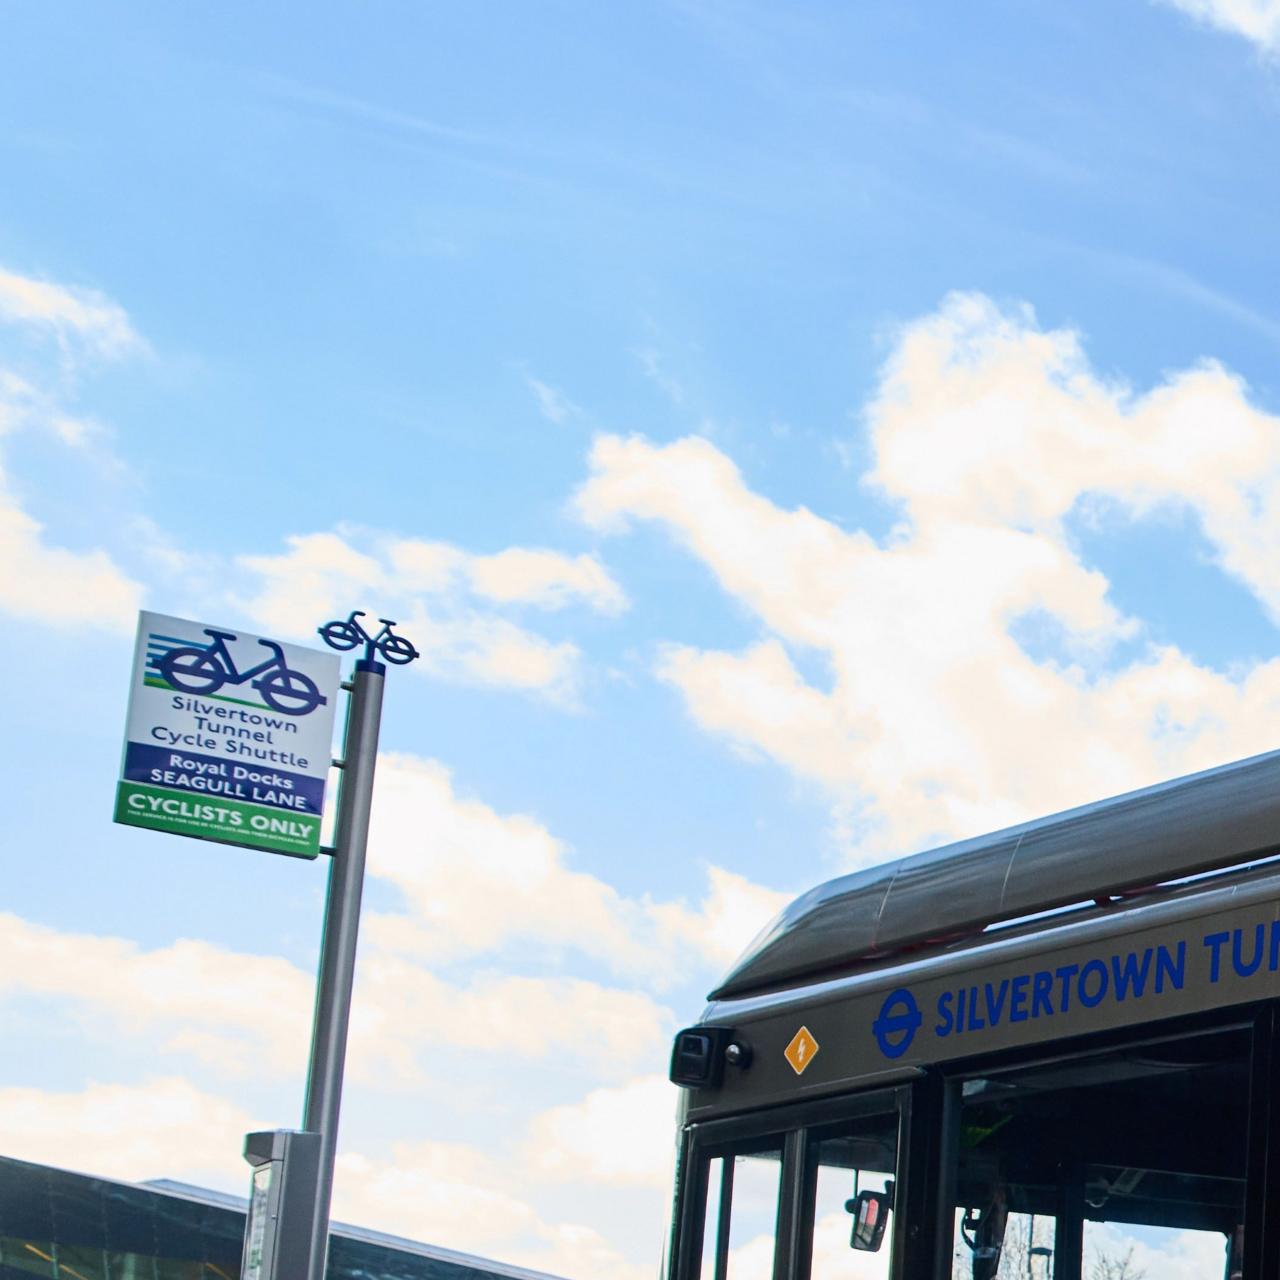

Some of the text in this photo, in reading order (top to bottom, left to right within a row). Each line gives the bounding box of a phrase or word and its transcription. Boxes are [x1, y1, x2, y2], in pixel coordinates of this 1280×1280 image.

[172, 695, 298, 734] Silvertown
[194, 716, 273, 745] Tunnel
[151, 726, 309, 769] Cycle Shuttle
[150, 768, 308, 810] SEAGULL LANE
[169, 754, 294, 790] Royal Docks
[127, 793, 315, 838] CYCLISTS ONLY
[934, 941, 1187, 1038] SILVERTOWN
